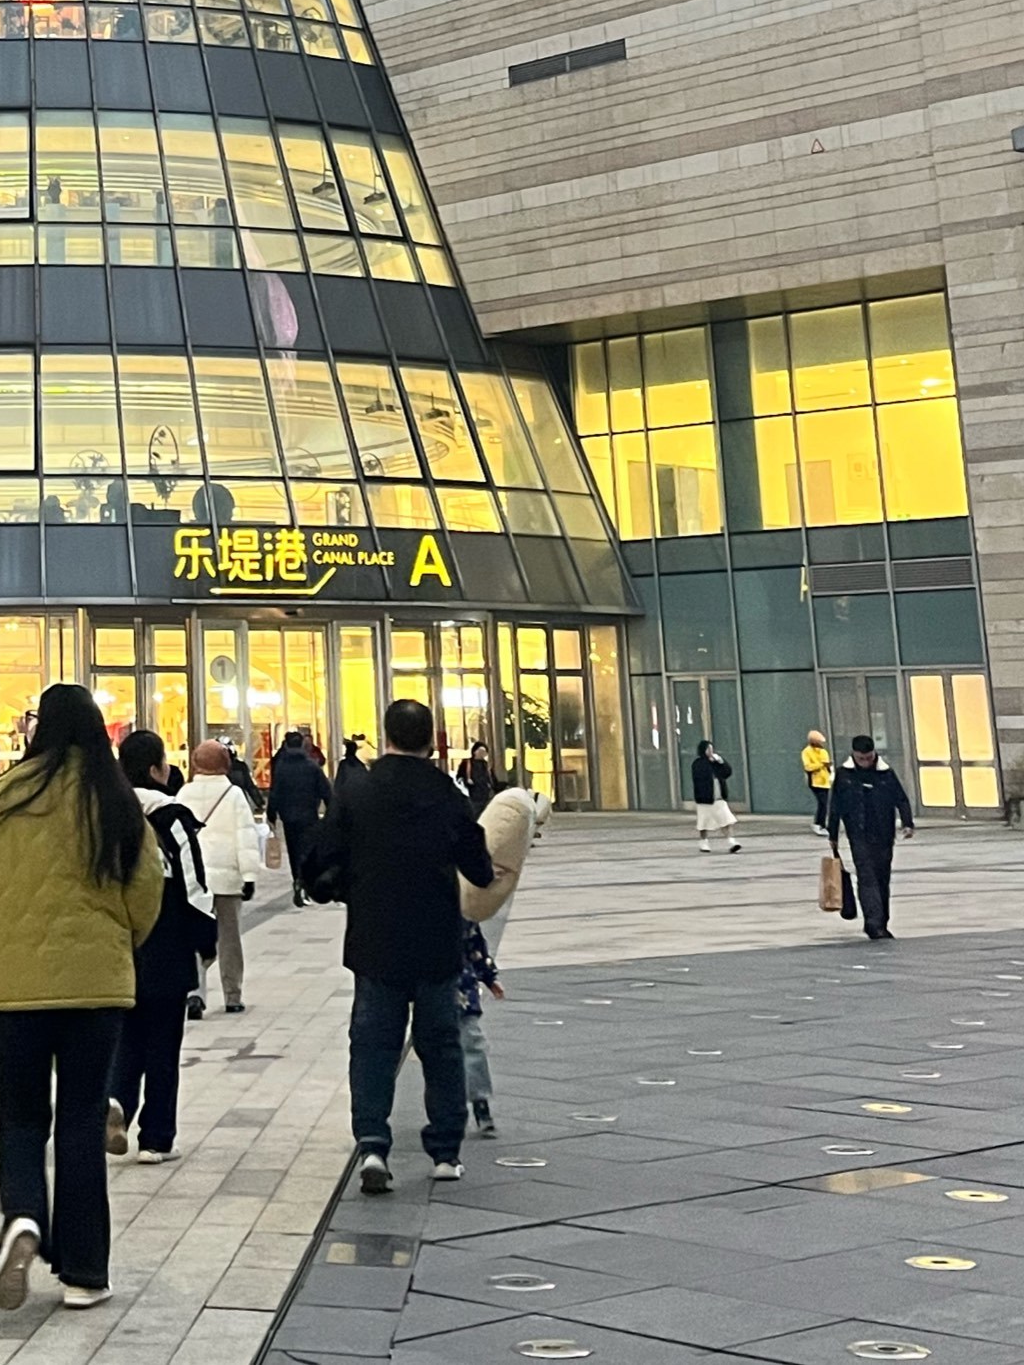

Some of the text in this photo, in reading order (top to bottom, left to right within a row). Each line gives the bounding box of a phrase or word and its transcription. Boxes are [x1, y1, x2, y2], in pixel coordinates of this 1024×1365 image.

[174, 527, 308, 582] 乐堤港
[312, 532, 359, 548] GRAND
[312, 549, 395, 566] CANAL PLACE
[409, 534, 452, 587] A
